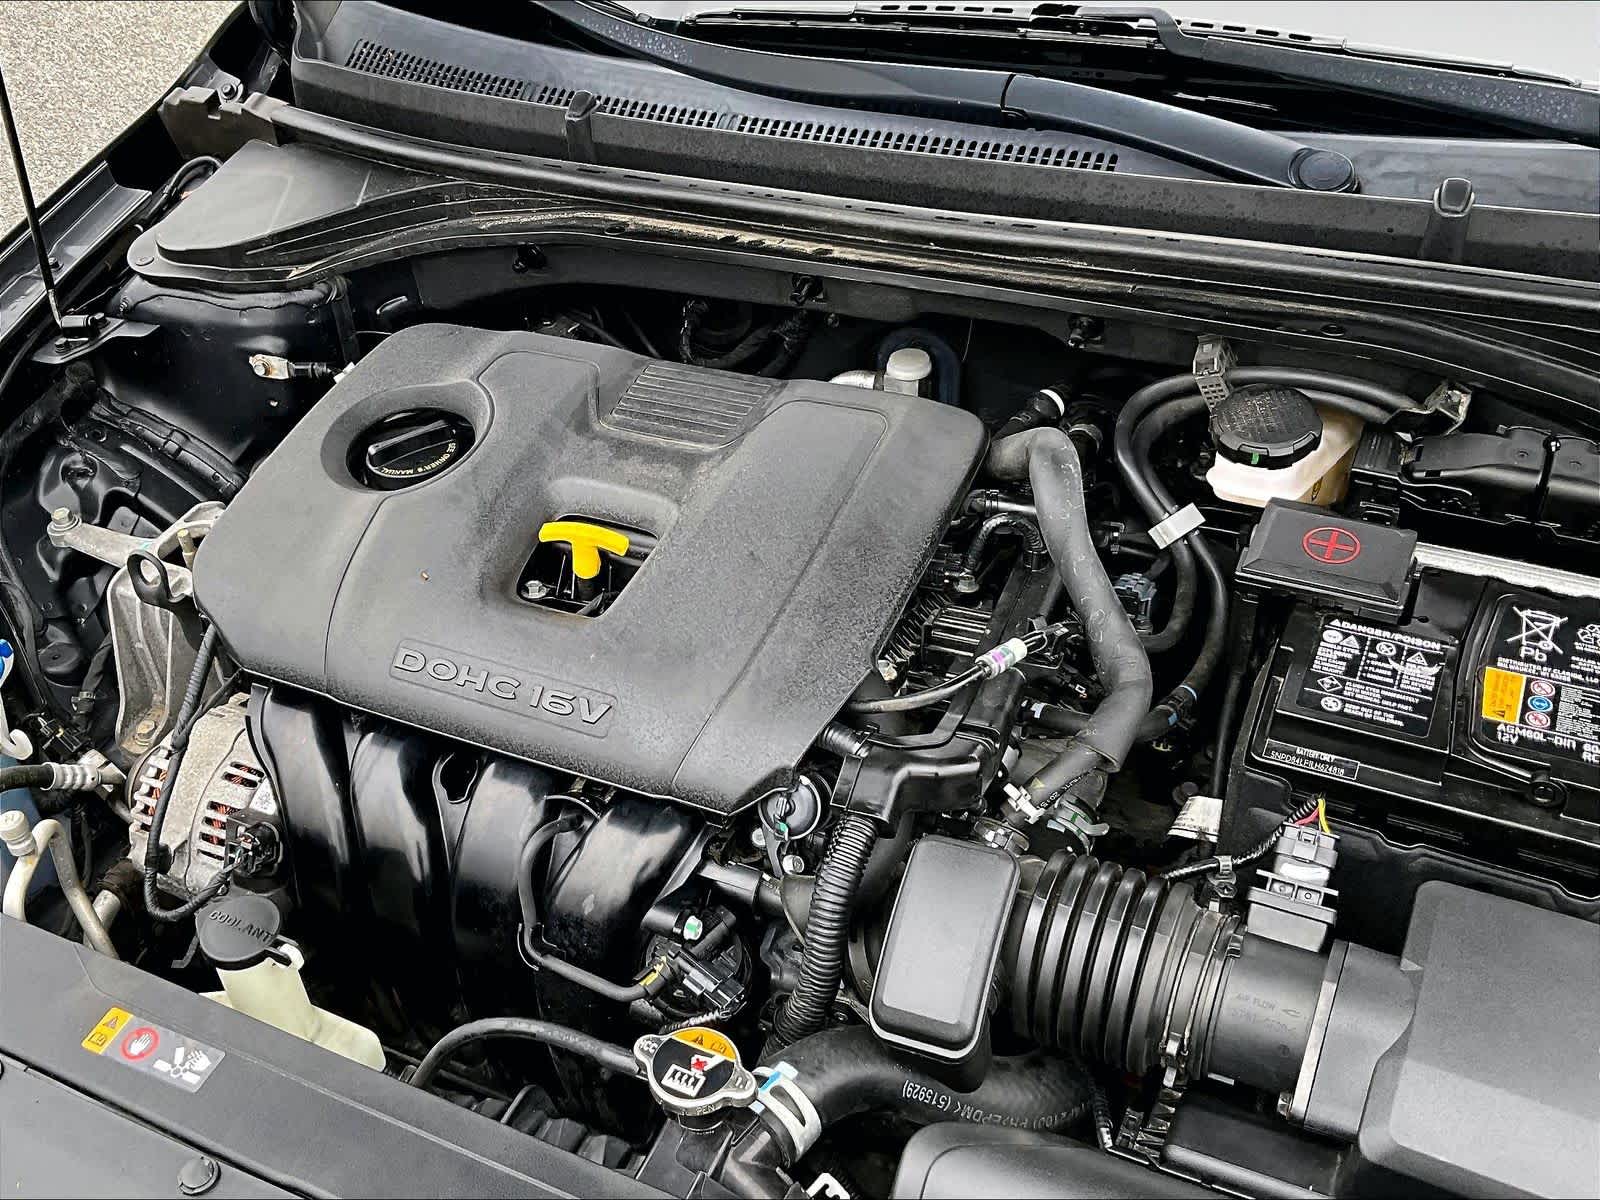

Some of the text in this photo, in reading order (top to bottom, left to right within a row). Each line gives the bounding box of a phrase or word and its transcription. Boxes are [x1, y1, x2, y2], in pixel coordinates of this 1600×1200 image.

[381, 442, 456, 475] SEE OWNER'S MANUAL
[1341, 620, 1440, 650] DANGER/POISON
[1520, 646, 1547, 662] Pb
[393, 648, 612, 724] DOHC 16V
[1497, 732, 1519, 745] 12V
[209, 911, 273, 943] COOLANT
[902, 1079, 952, 1112] (515929)
